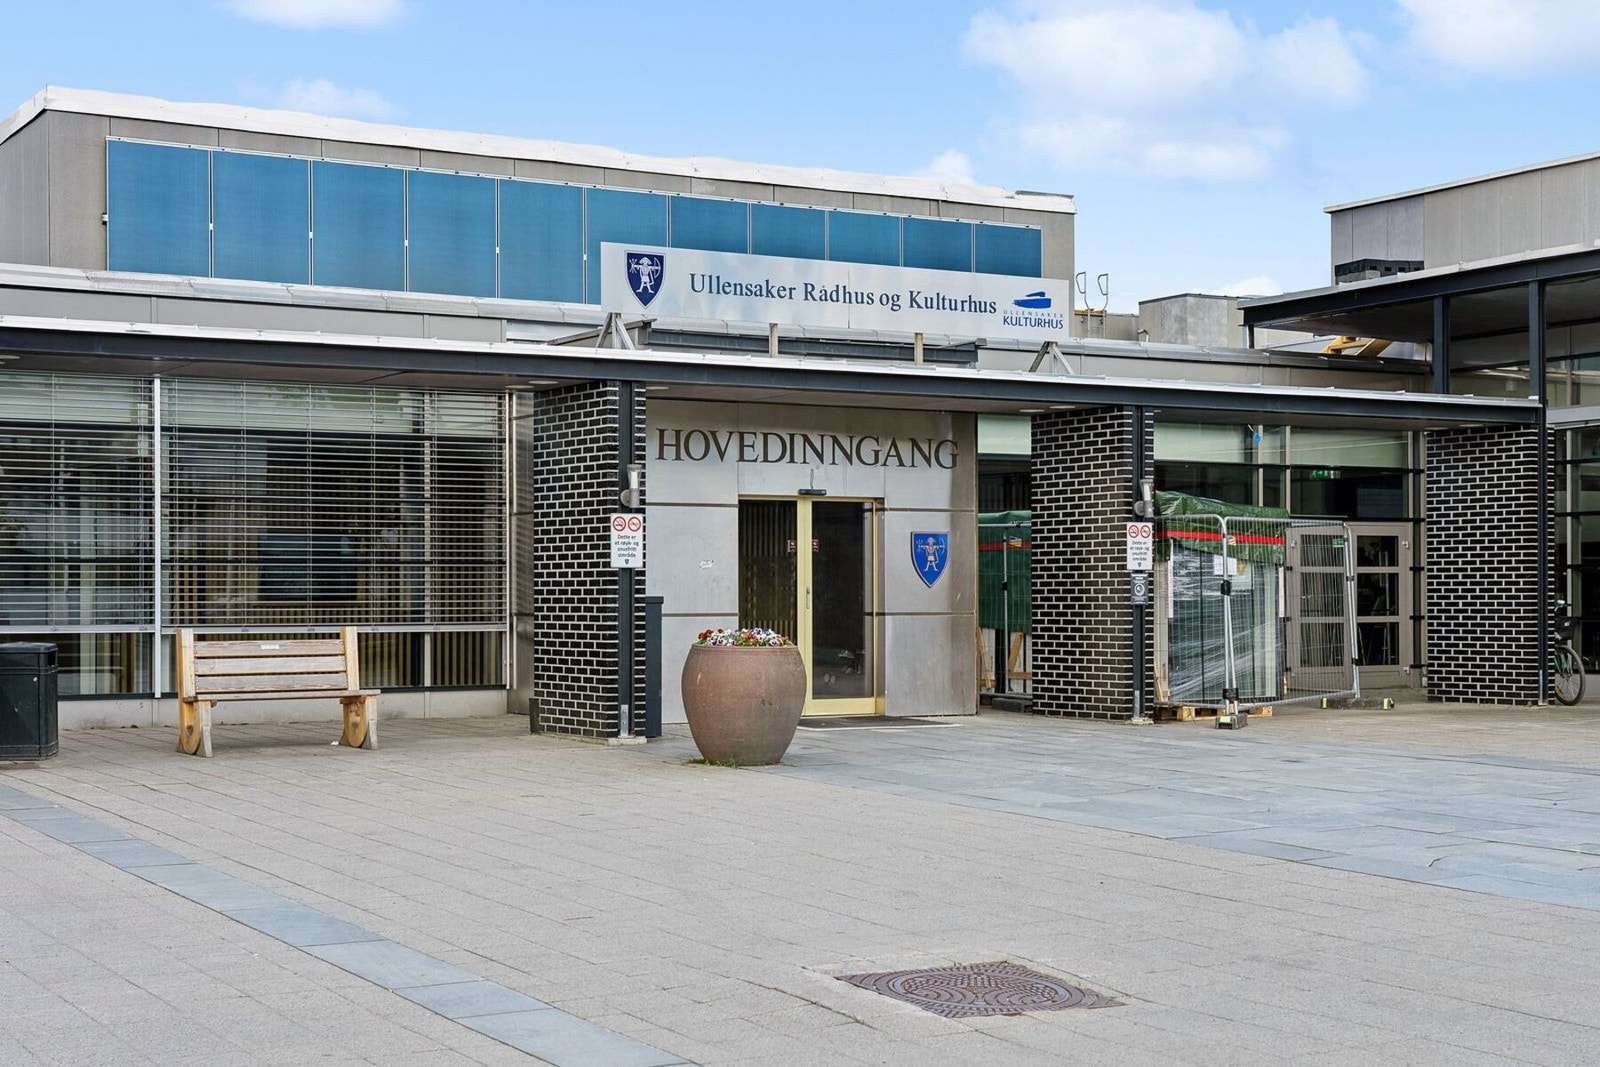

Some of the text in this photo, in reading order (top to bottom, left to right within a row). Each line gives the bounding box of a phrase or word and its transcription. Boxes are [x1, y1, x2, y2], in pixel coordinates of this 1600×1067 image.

[689, 273, 997, 314] Ullensaker Rådhus og Kulturhus
[1003, 310, 1063, 318] ULLENSAKER
[1003, 315, 1064, 329] KULTURHUS
[655, 427, 960, 470] HOVEDINNGANG
